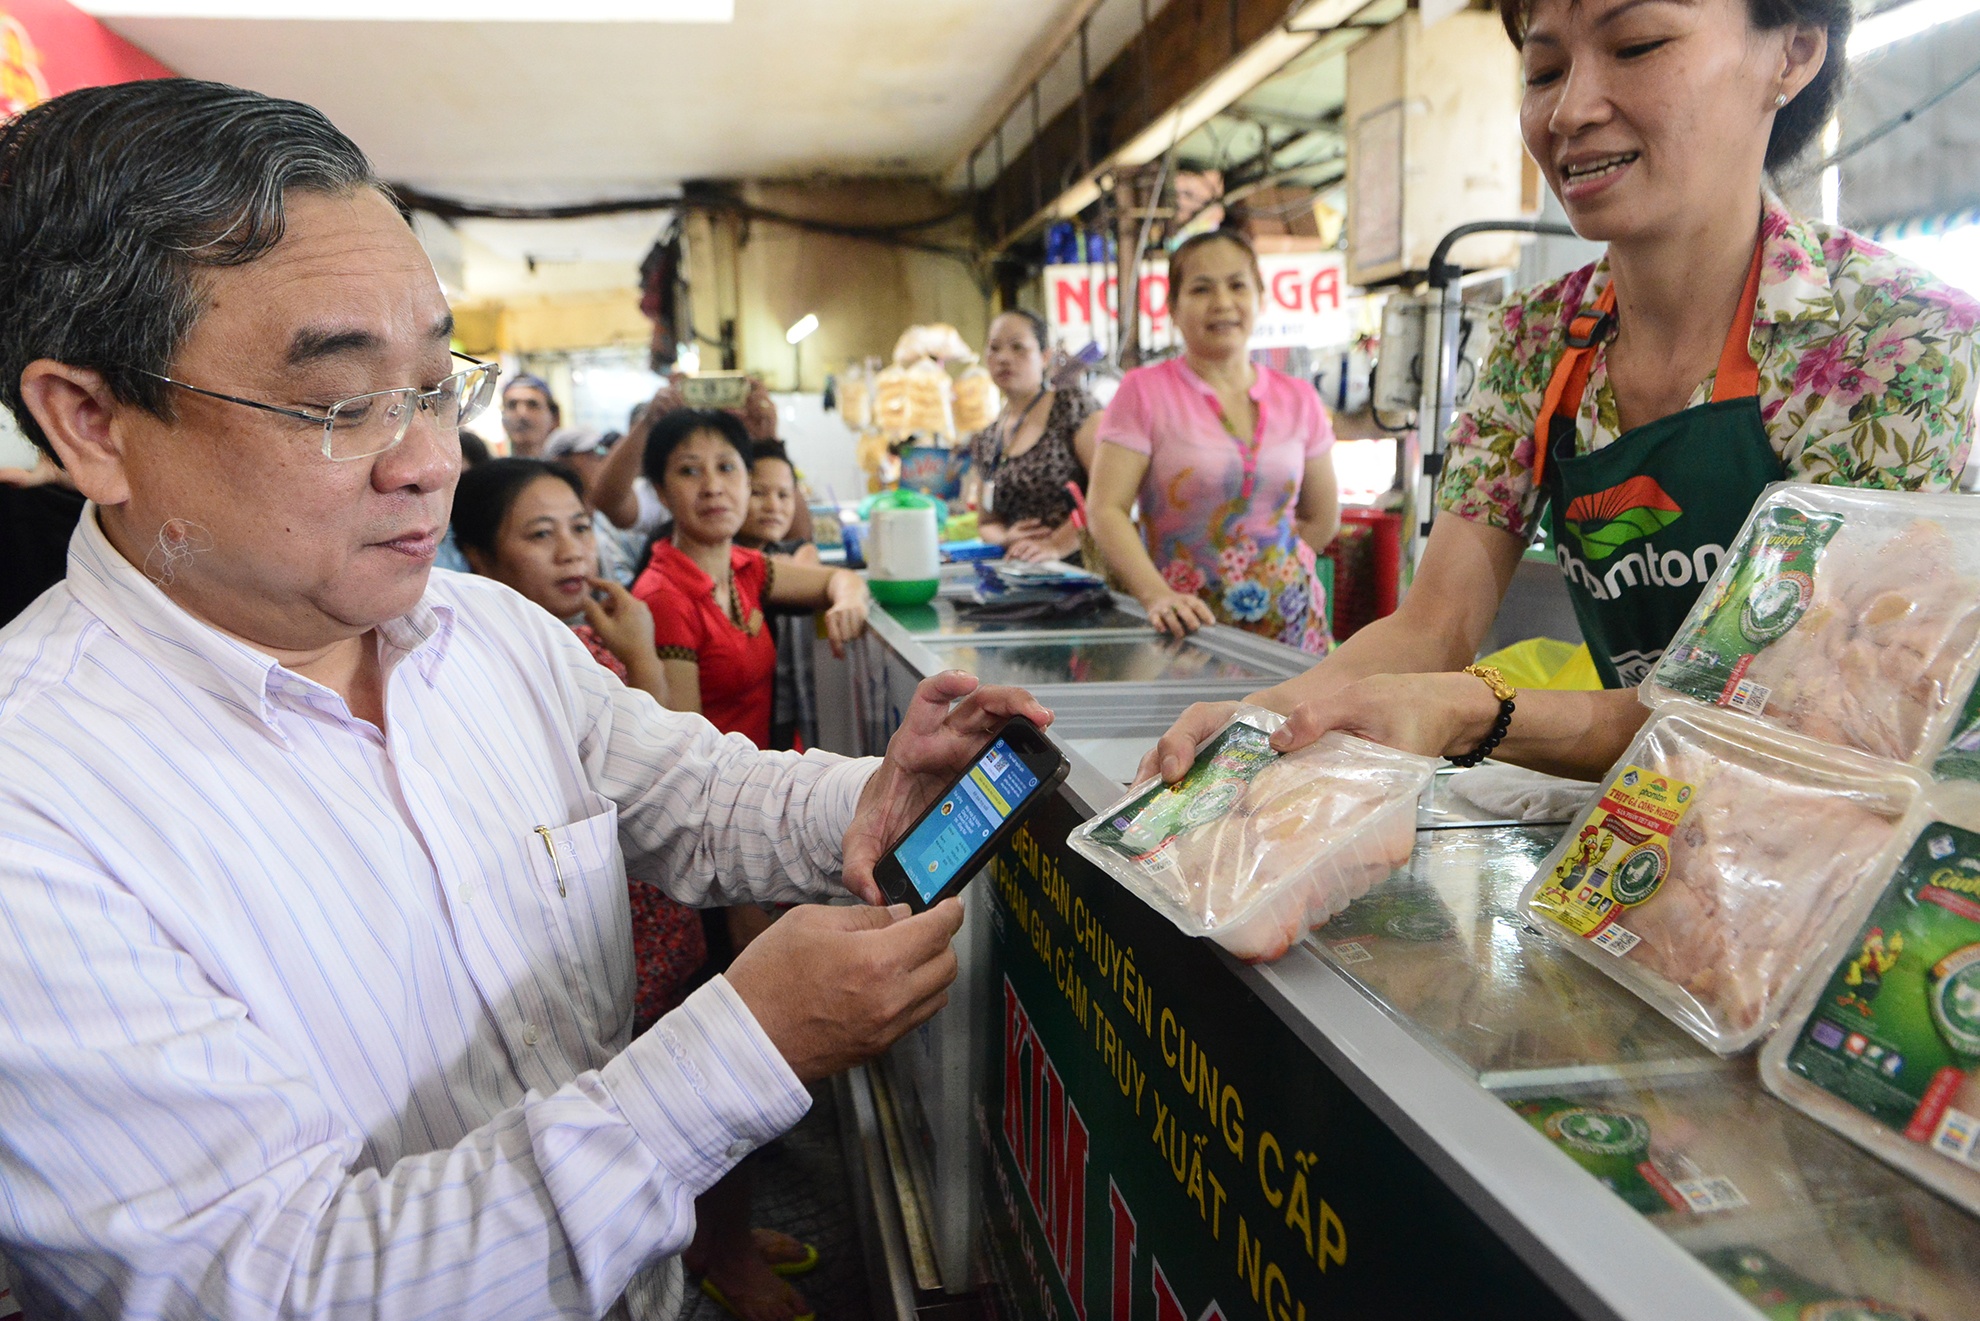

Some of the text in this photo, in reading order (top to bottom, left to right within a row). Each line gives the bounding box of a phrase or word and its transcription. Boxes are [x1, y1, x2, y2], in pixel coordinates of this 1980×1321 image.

[1609, 788, 1630, 805] THỊT
[1003, 971, 1090, 1321] KIM
[1031, 909, 1052, 973] GIA
[1056, 946, 1088, 1031] CẦM
[1093, 1000, 1146, 1117] TRUY
[1152, 1089, 1228, 1241] XUẤT
[1042, 853, 1070, 925] BÁN
[1074, 896, 1152, 1039] CHUYÊN
[1160, 1007, 1244, 1163] CUNG
[1258, 1130, 1348, 1274] CẤP
